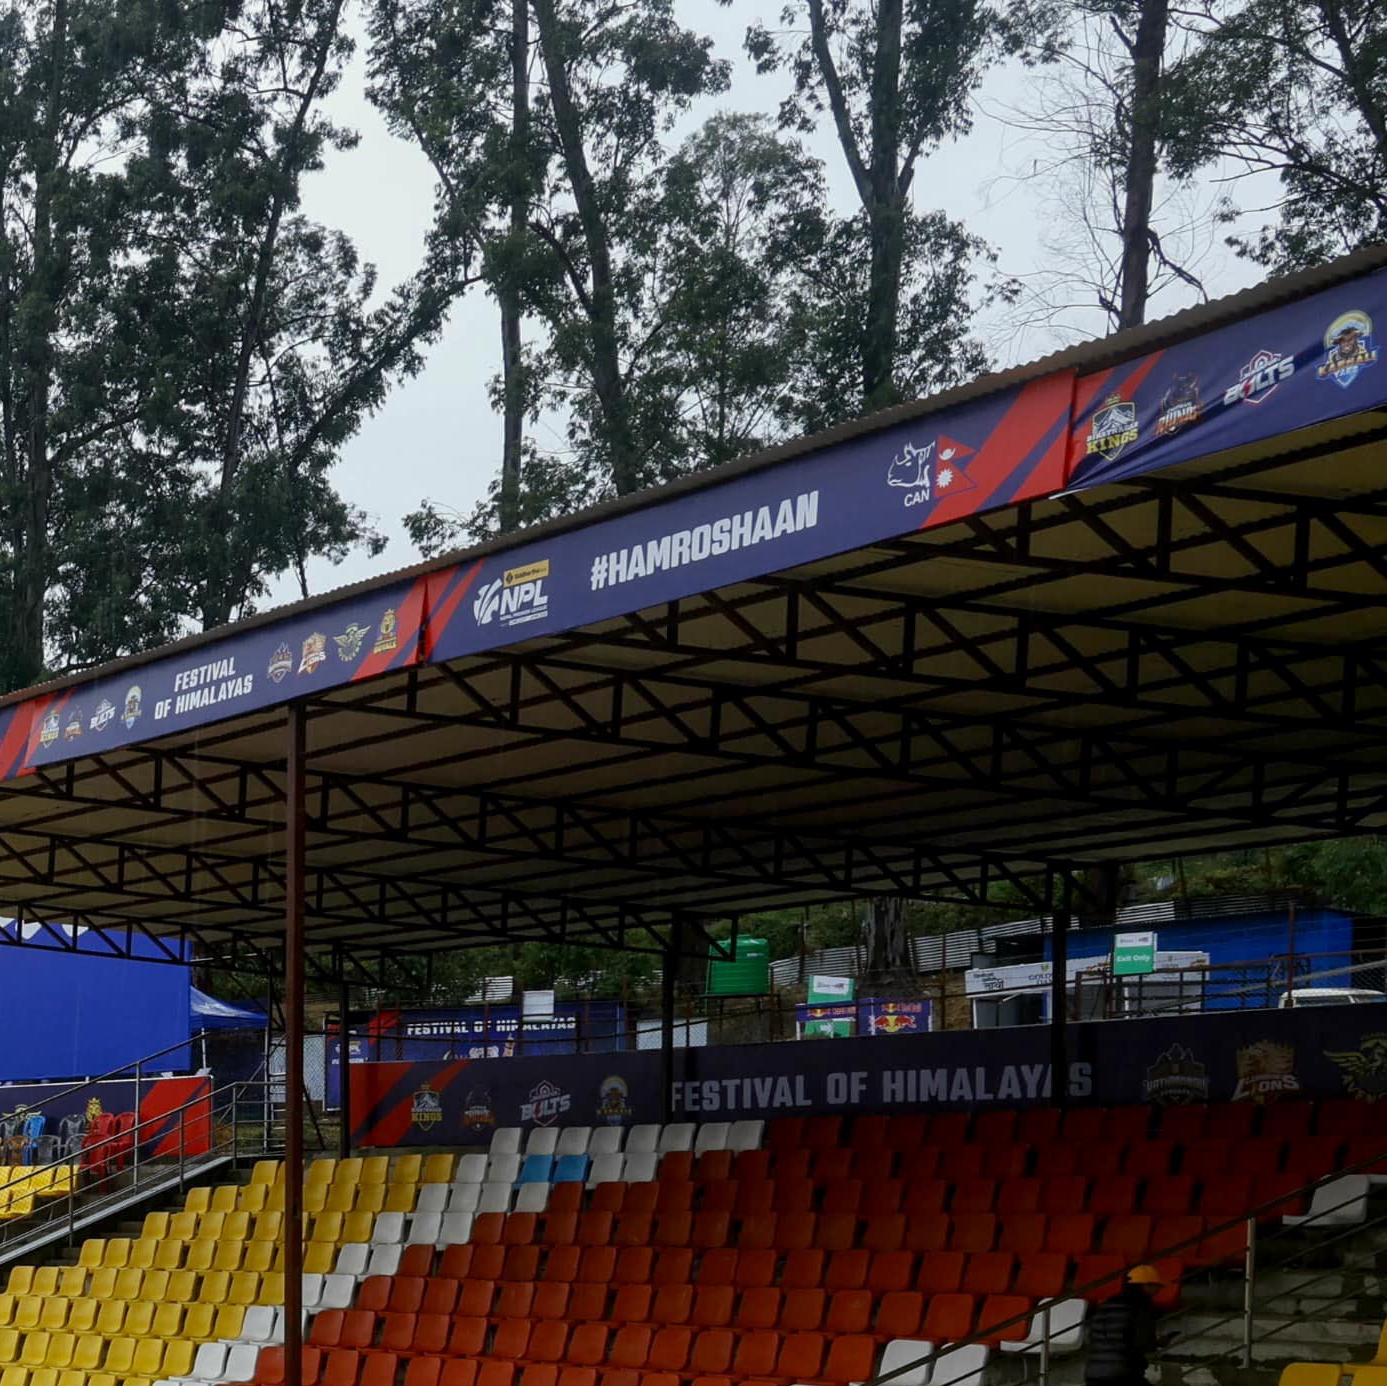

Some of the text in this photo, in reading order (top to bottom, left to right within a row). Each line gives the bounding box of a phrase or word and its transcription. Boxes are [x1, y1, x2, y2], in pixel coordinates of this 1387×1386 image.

[1087, 428, 1139, 454] KINGS
[903, 488, 930, 508] CAN
[591, 490, 820, 590] #HAMROSHAAN
[499, 579, 548, 616] NPL
[174, 656, 236, 693] FESTIVAL
[154, 677, 252, 720] OF HIMALAYAS
[519, 1094, 571, 1121] BOLTS
[671, 1075, 811, 1112] FESTIVAL
[827, 1071, 867, 1104] OF
